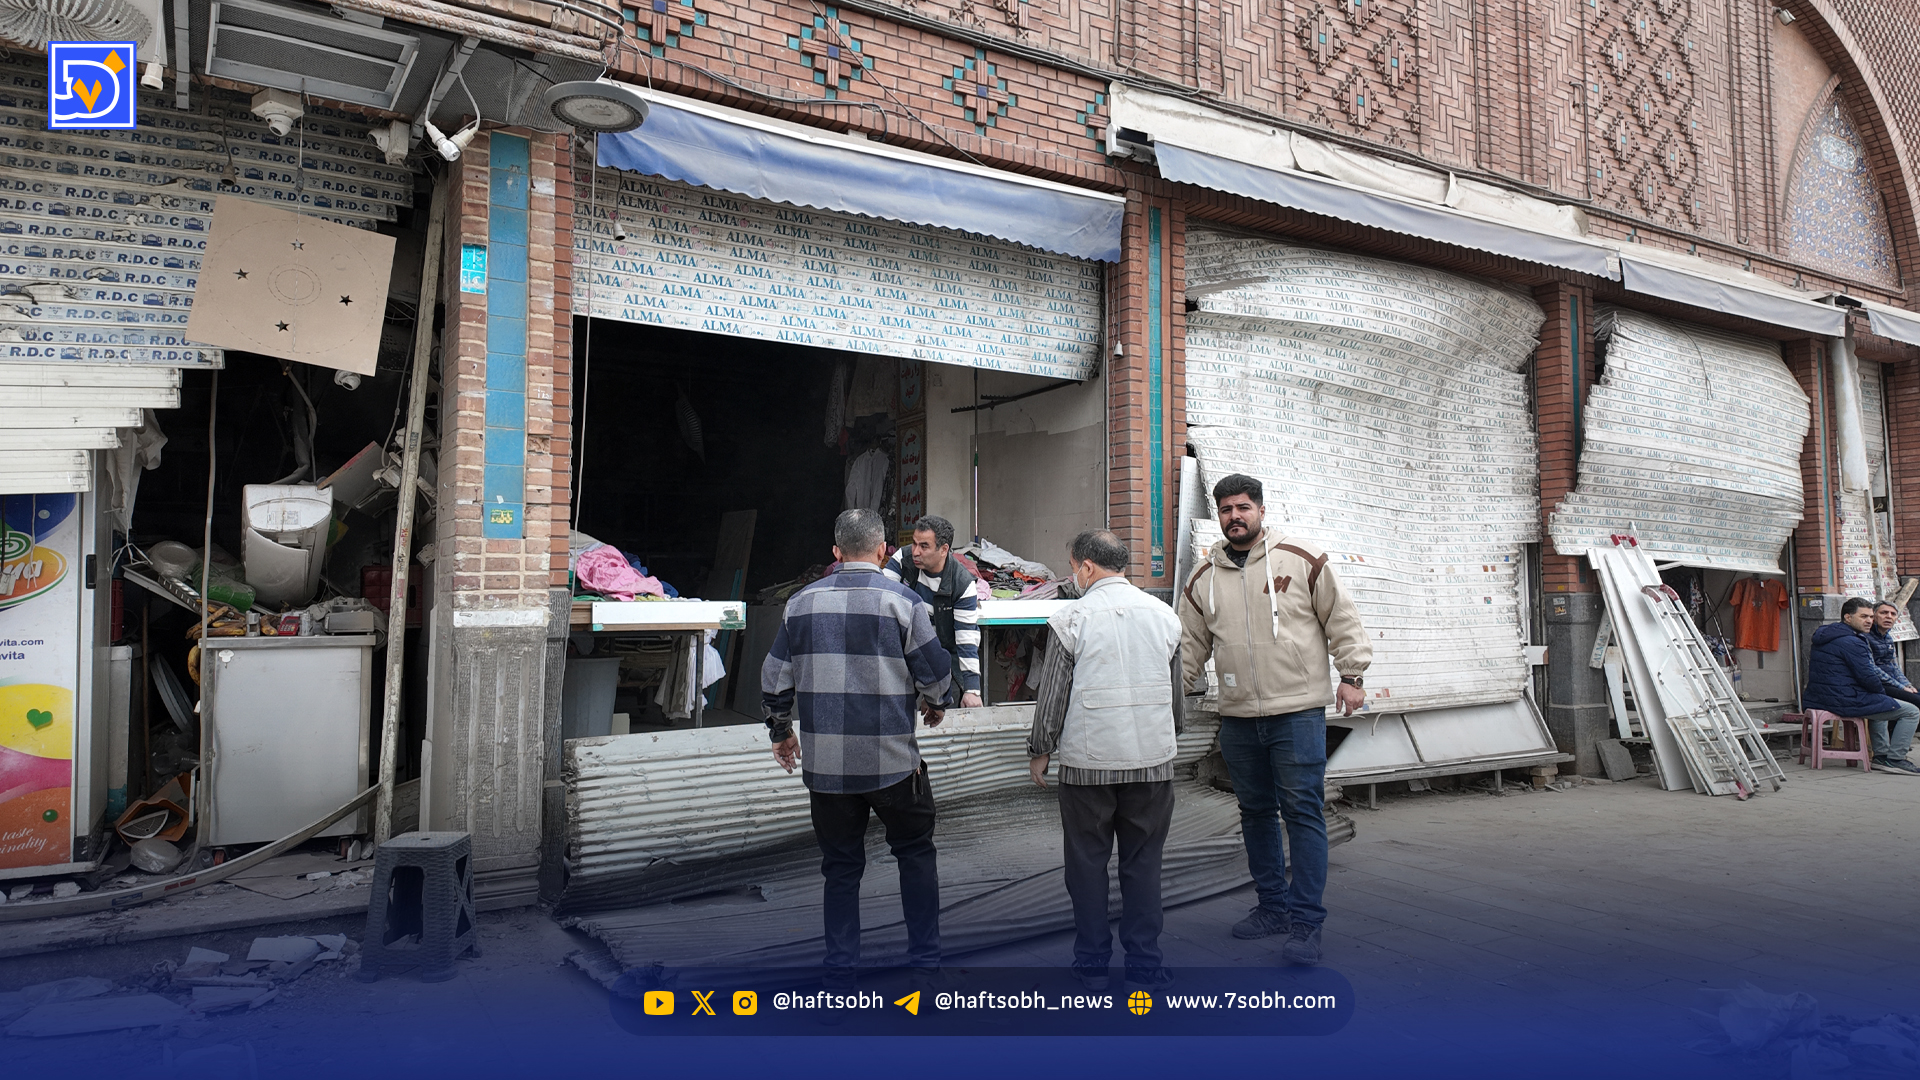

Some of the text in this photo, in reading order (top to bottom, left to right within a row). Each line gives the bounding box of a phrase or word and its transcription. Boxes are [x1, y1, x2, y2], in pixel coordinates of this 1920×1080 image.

[574, 203, 1072, 301] LMA ALMA ALMA ALMA ALMA ALMA ALMA ALMA
[619, 195, 1053, 283] ALMA ALMA ALMA ALMA ALMA ALMA ALMA
[620, 180, 1053, 270] ALMA ALMA ALMA ALMA ALMA ALMA ALMA
[612, 260, 655, 276] ALMA
[693, 272, 733, 288] ALMA
[769, 284, 805, 299] ALMA
[838, 295, 873, 309] ALMA
[904, 305, 936, 318] ALMA
[965, 315, 995, 328] ALMA
[1022, 324, 1050, 336] ALMA
[651, 233, 1075, 314] ALMA ALMA ALMA ALMA ALMA ALMA ALMA
[655, 251, 697, 268] ALMA
[734, 264, 772, 279] ALMA
[806, 276, 842, 290] ALMA
[874, 287, 907, 300] ALMA
[937, 297, 968, 310] ALMA
[996, 306, 1026, 319] ALMA
[1052, 316, 1080, 328] ALMA
[620, 308, 1053, 376] ALMA ALMA ALMA ALMA ALMA ALMA ALMA
[624, 294, 1057, 363] ALMA ALMA ALMA ALMA ALMA ALMA ALMA
[661, 283, 701, 299] ALMA
[739, 295, 777, 309] ALMA
[811, 305, 847, 320] ALMA
[879, 315, 912, 329] ALMA
[941, 325, 973, 338] ALMA
[1001, 334, 1030, 346] ALMA
[1055, 342, 1081, 354] ALMA
[0, 836, 48, 855] inality
[2, 827, 34, 841] taste
